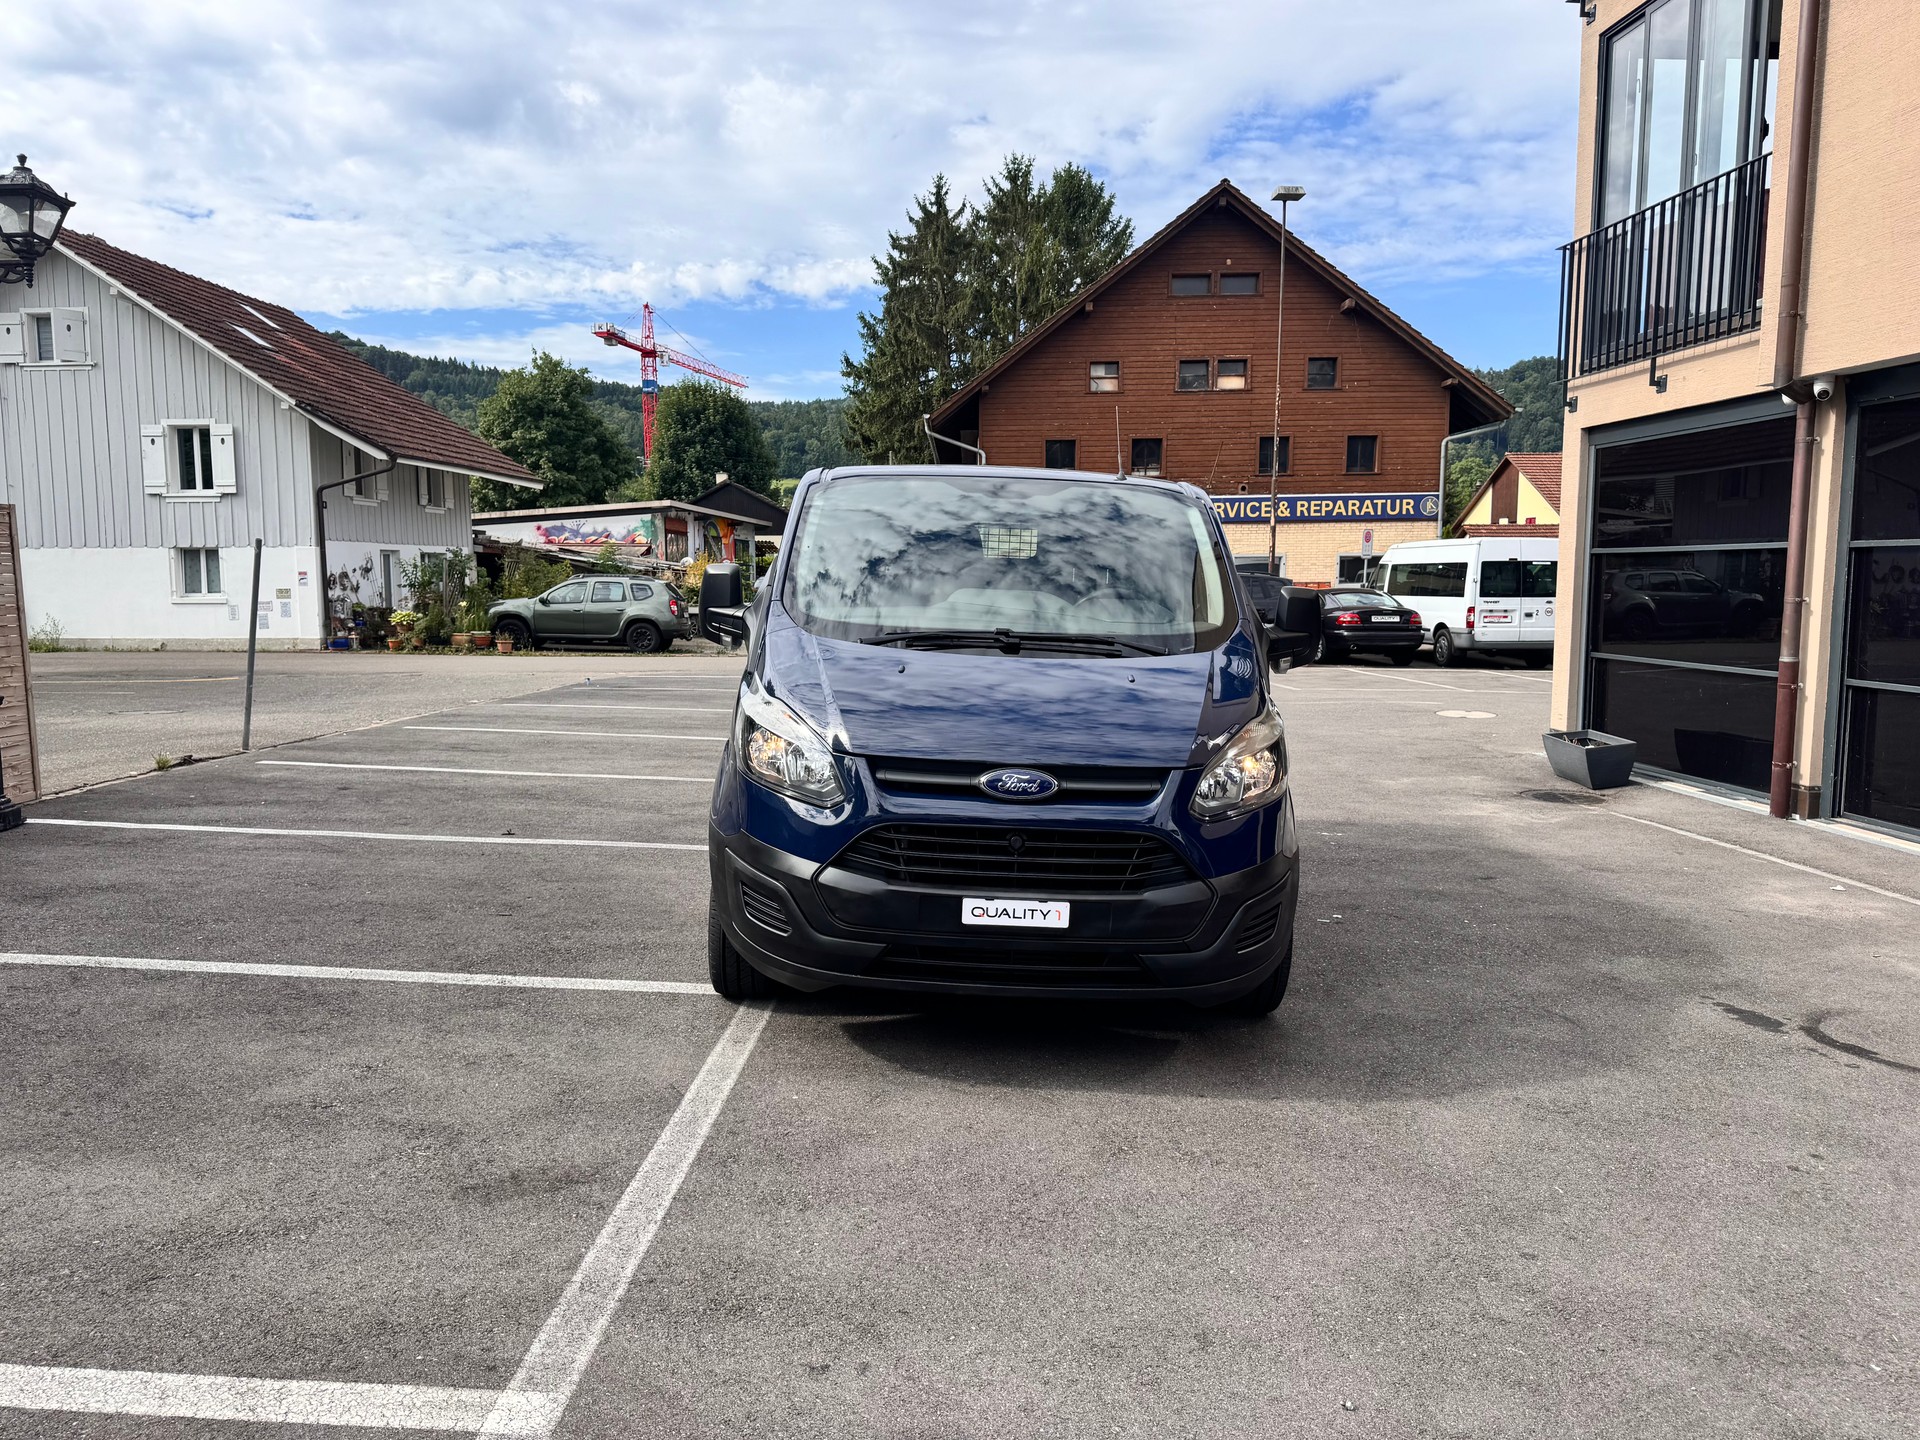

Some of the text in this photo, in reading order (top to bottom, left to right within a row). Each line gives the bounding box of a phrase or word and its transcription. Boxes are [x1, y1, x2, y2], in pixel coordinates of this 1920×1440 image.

[1214, 499, 1415, 518] RVICE & REPARATUR
[997, 773, 1041, 793] Ford
[971, 905, 1052, 921] QUALITY
